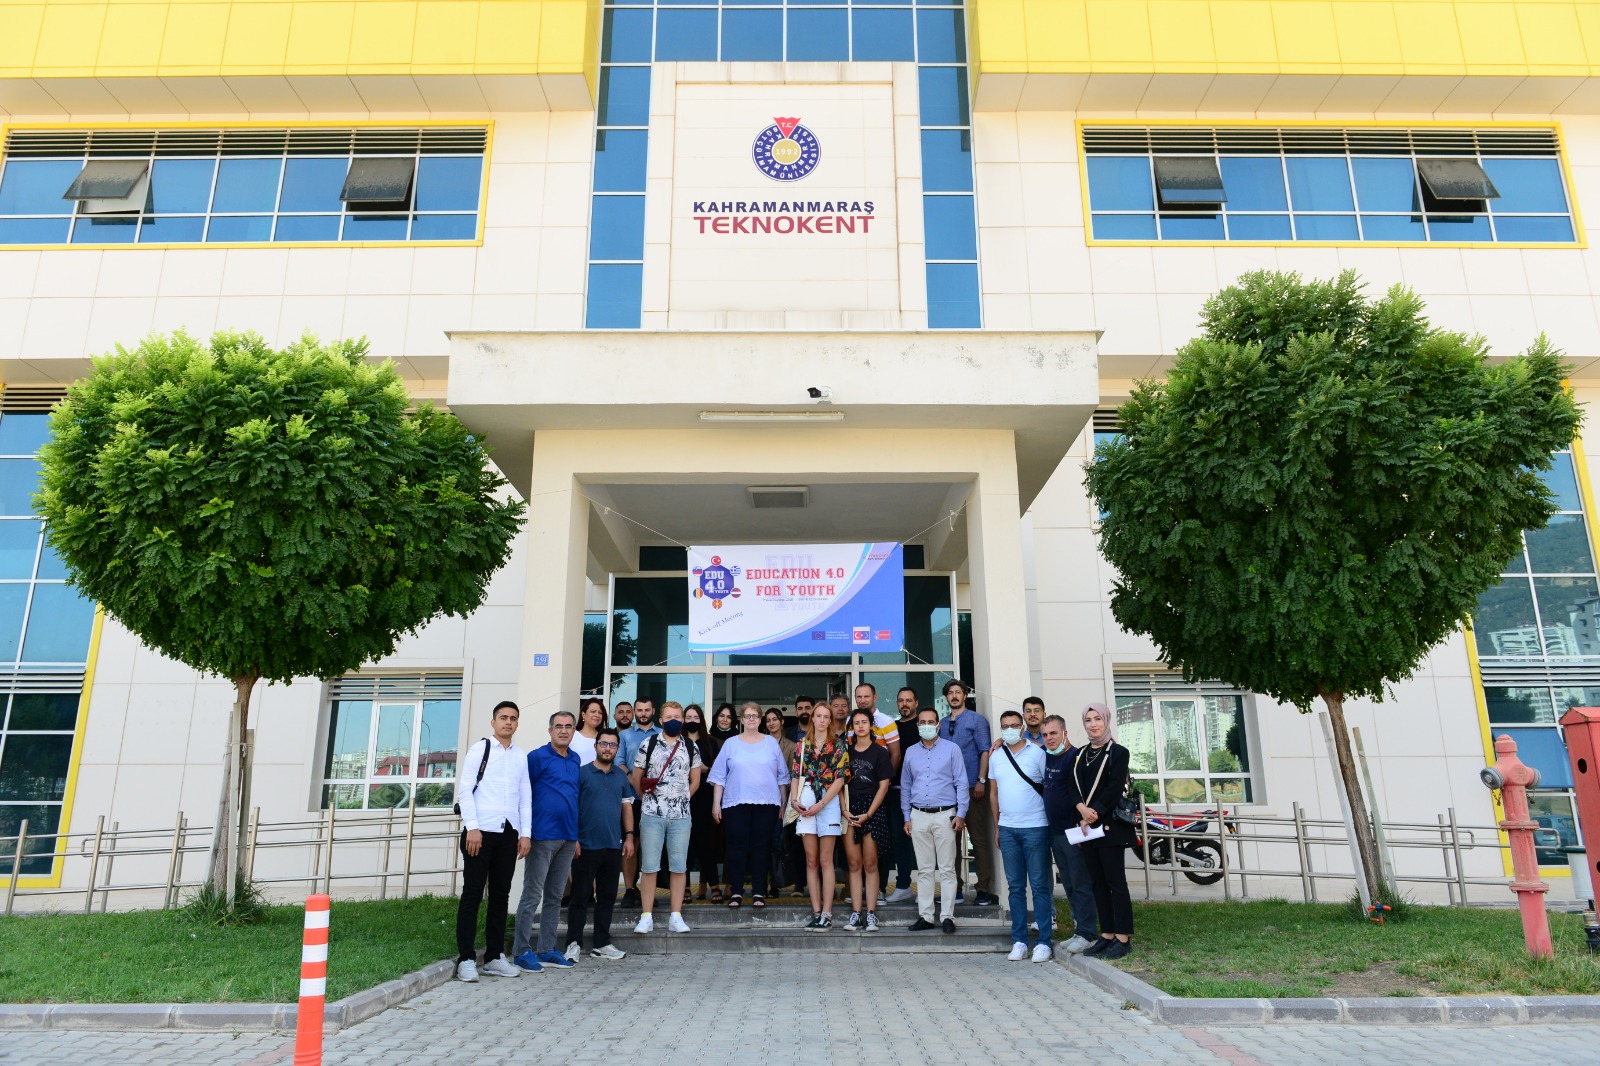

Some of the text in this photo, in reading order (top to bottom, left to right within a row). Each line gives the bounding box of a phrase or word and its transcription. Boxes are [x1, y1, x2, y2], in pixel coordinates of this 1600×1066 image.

[775, 148, 798, 156] 1992
[693, 201, 875, 215] KAHRAMANMARAŞ
[693, 215, 875, 234] TEKNOKENT
[704, 570, 725, 580] EDU
[745, 567, 845, 580] EDUCATION 4.0
[704, 580, 725, 594] 4.0
[756, 584, 836, 597] FOR YOUTH
[698, 620, 721, 636] Kick-off
